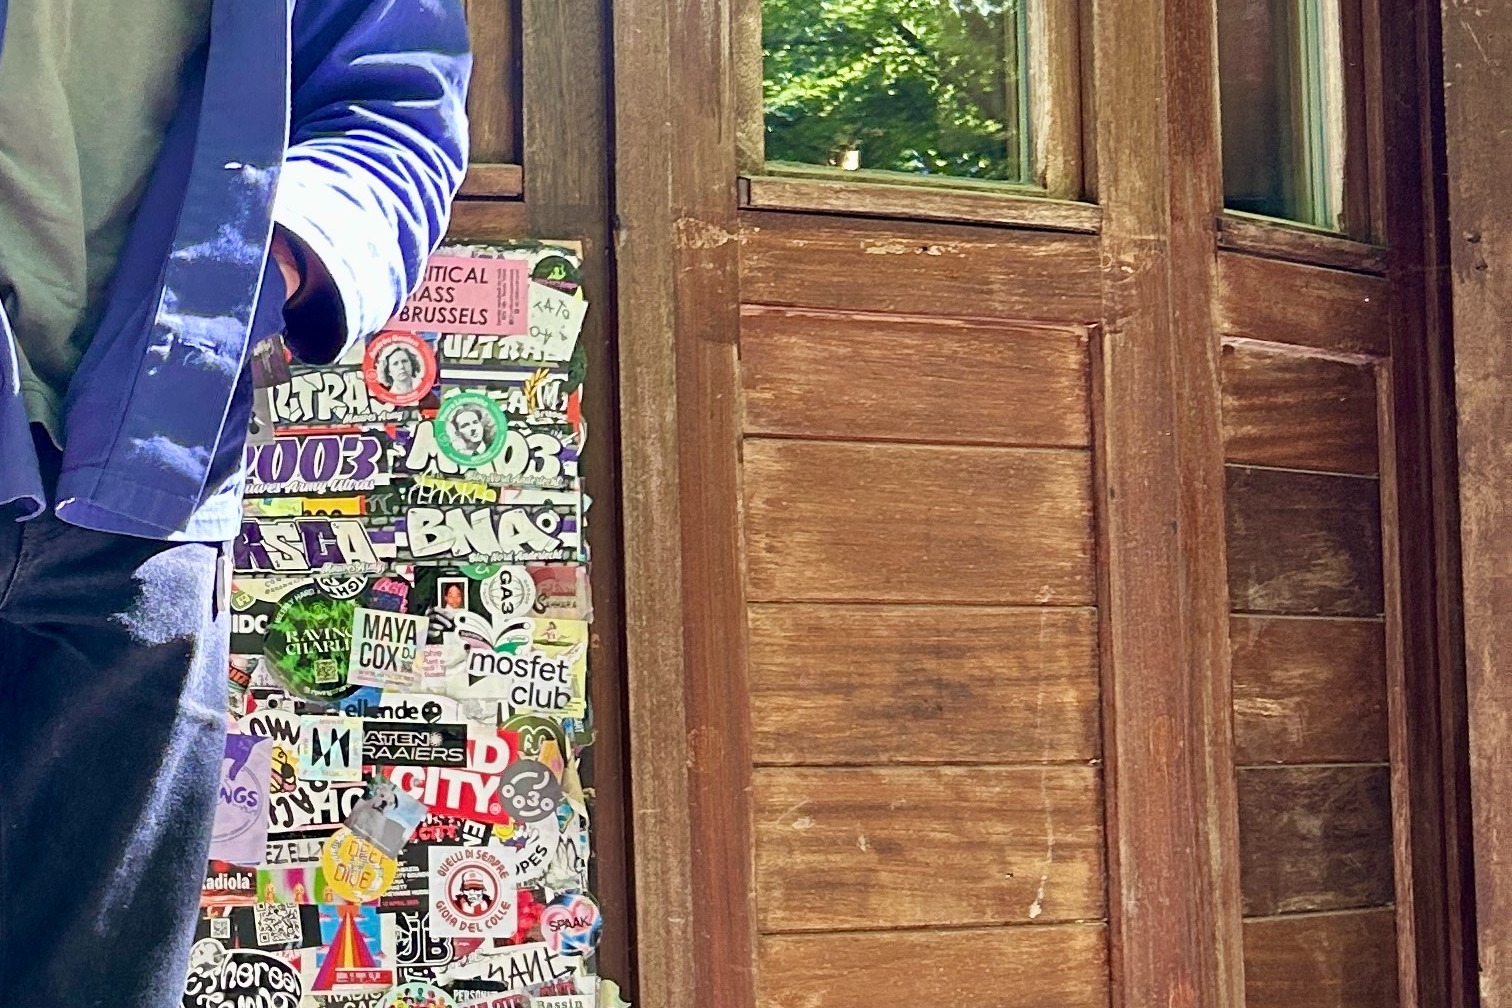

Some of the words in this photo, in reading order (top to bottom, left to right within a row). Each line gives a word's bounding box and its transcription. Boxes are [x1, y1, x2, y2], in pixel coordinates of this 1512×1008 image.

[399, 305, 488, 325] BRUSSELS
[330, 478, 376, 492] Ultras
[362, 613, 418, 645] MAYA
[359, 642, 400, 672] COX
[401, 646, 417, 660] DJ
[469, 651, 569, 684] mosfet
[511, 682, 571, 710] club
[390, 765, 502, 814] CITY
[475, 849, 510, 880] SEMPRE
[459, 921, 483, 933] DEL
[486, 900, 511, 930] COLLE
